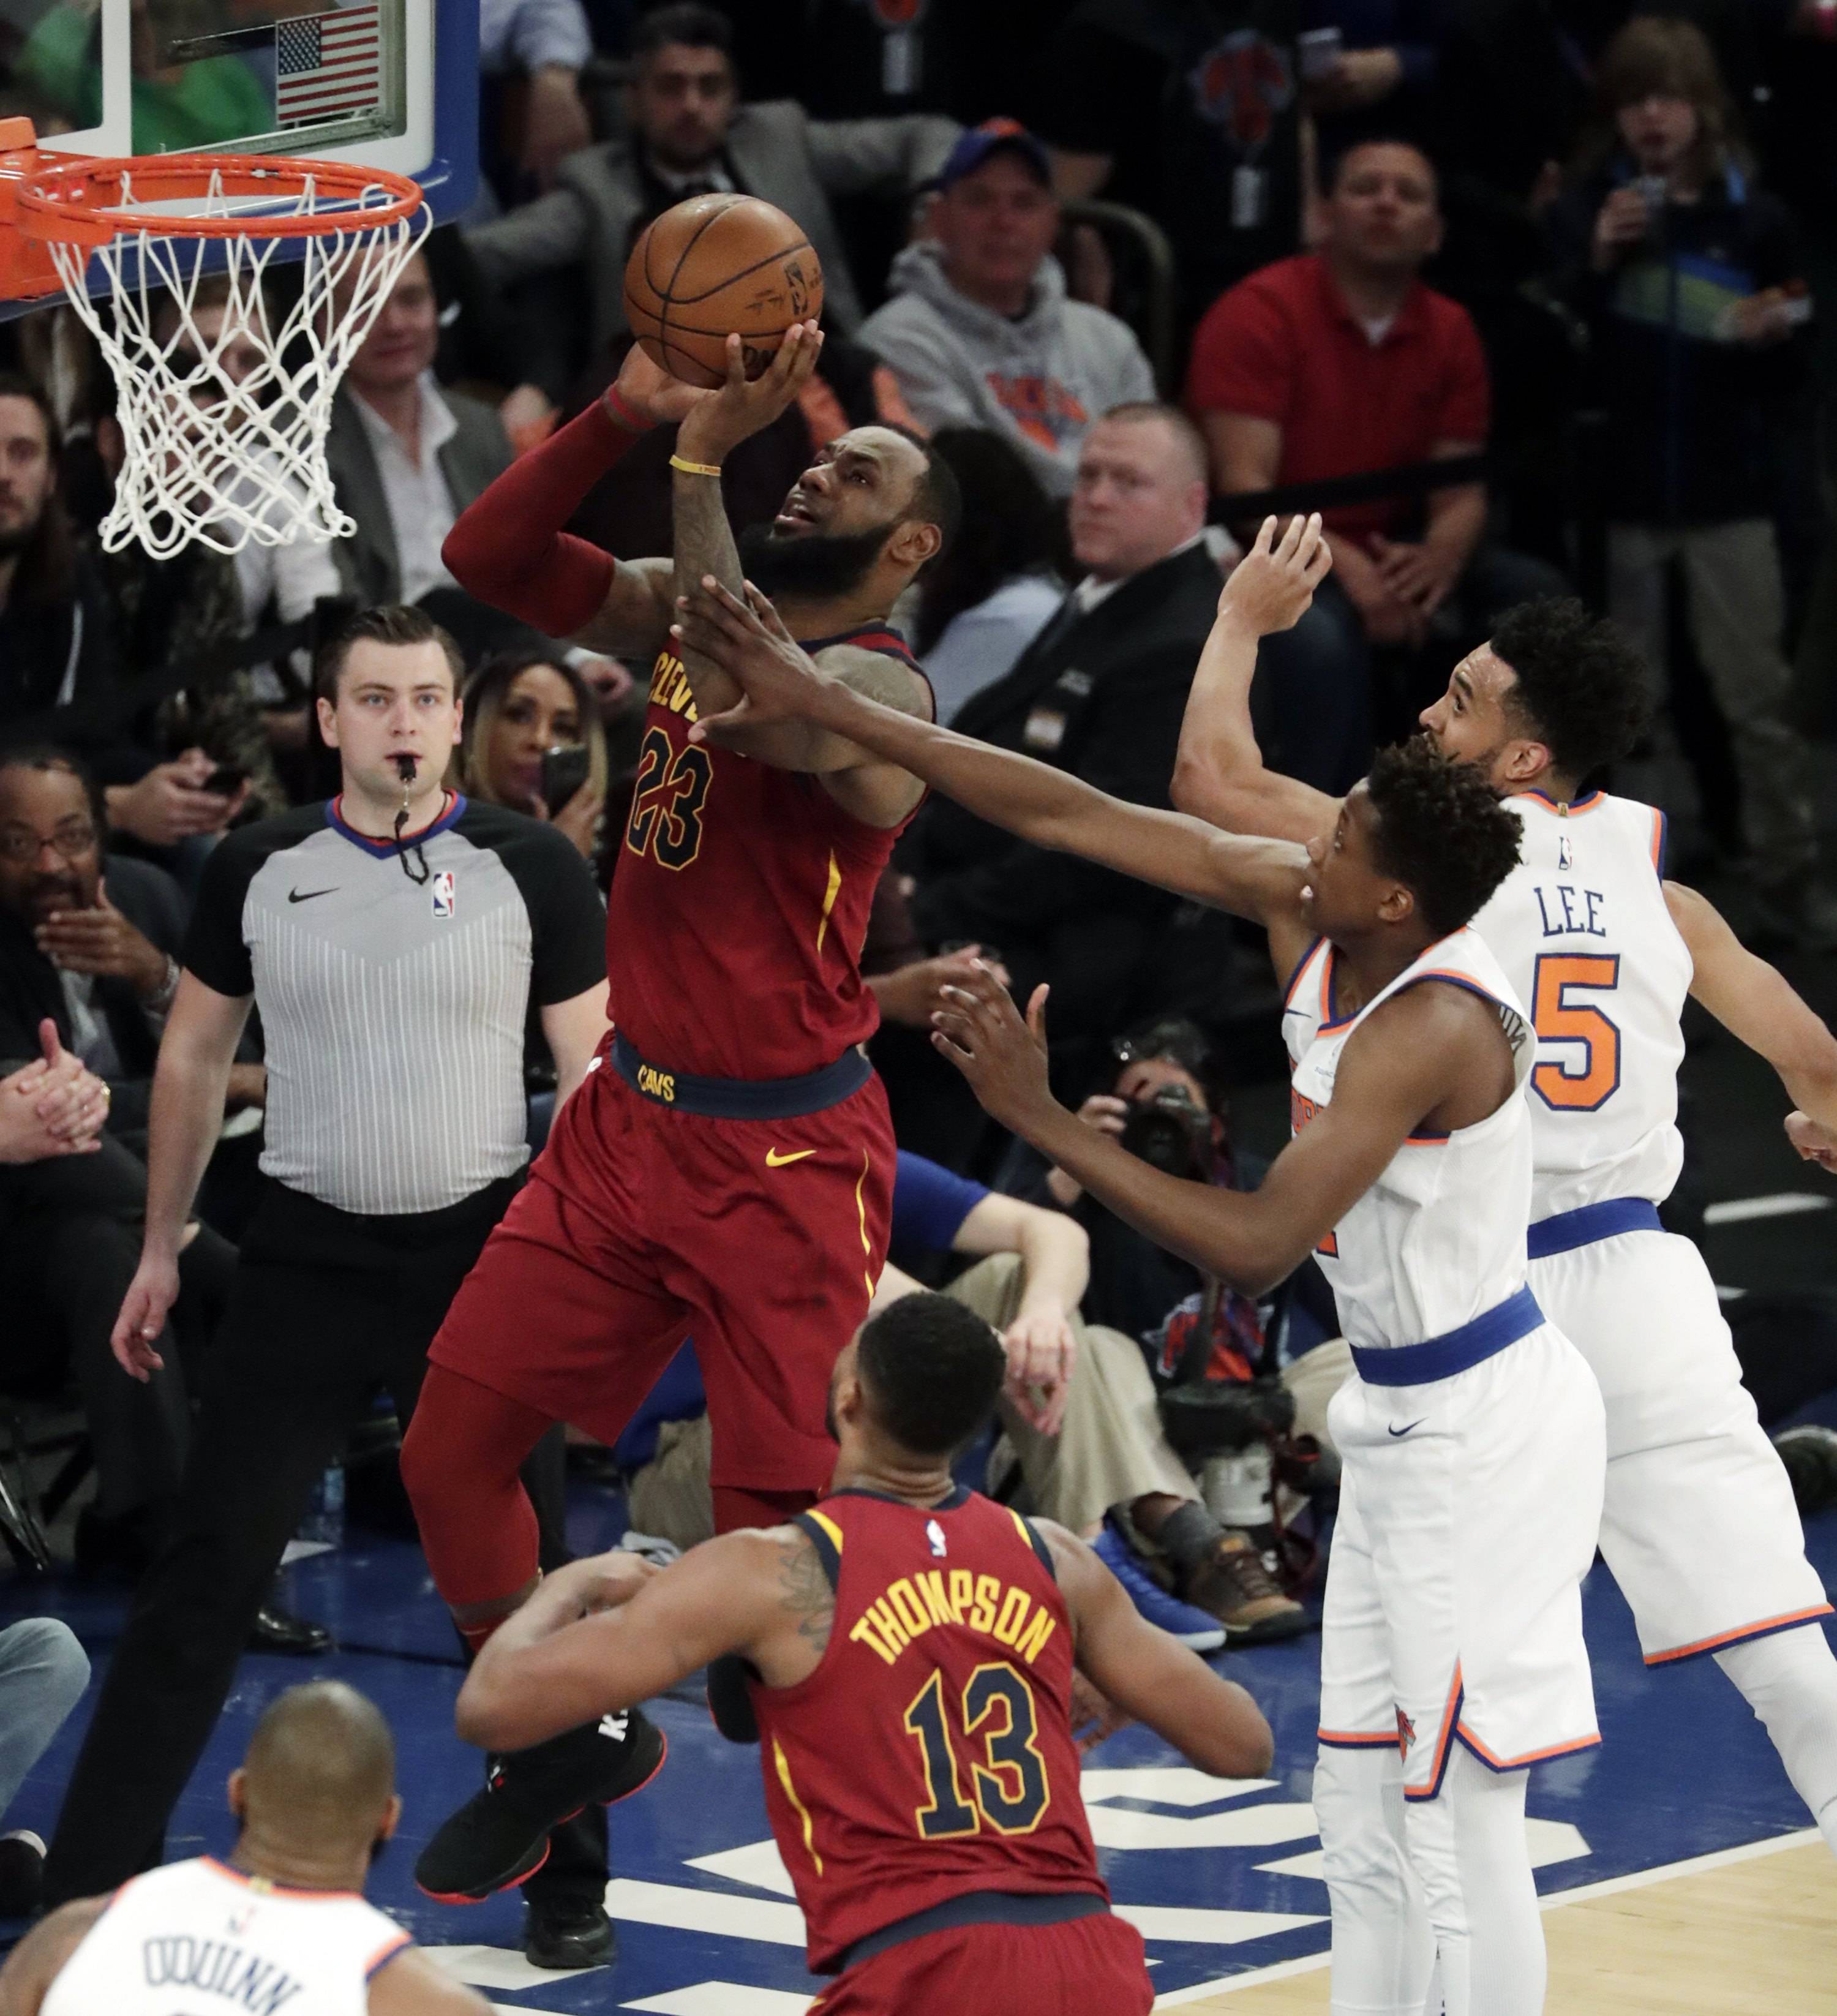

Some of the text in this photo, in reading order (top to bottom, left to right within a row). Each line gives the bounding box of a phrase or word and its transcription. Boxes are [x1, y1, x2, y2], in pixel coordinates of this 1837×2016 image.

[626, 725, 713, 871] 23
[1533, 885, 1607, 938] LEE
[637, 1064, 675, 1102] CAVS
[1530, 952, 1621, 1112] 5
[849, 1569, 1056, 1666] THOMPSON
[903, 1661, 1051, 1840] 13
